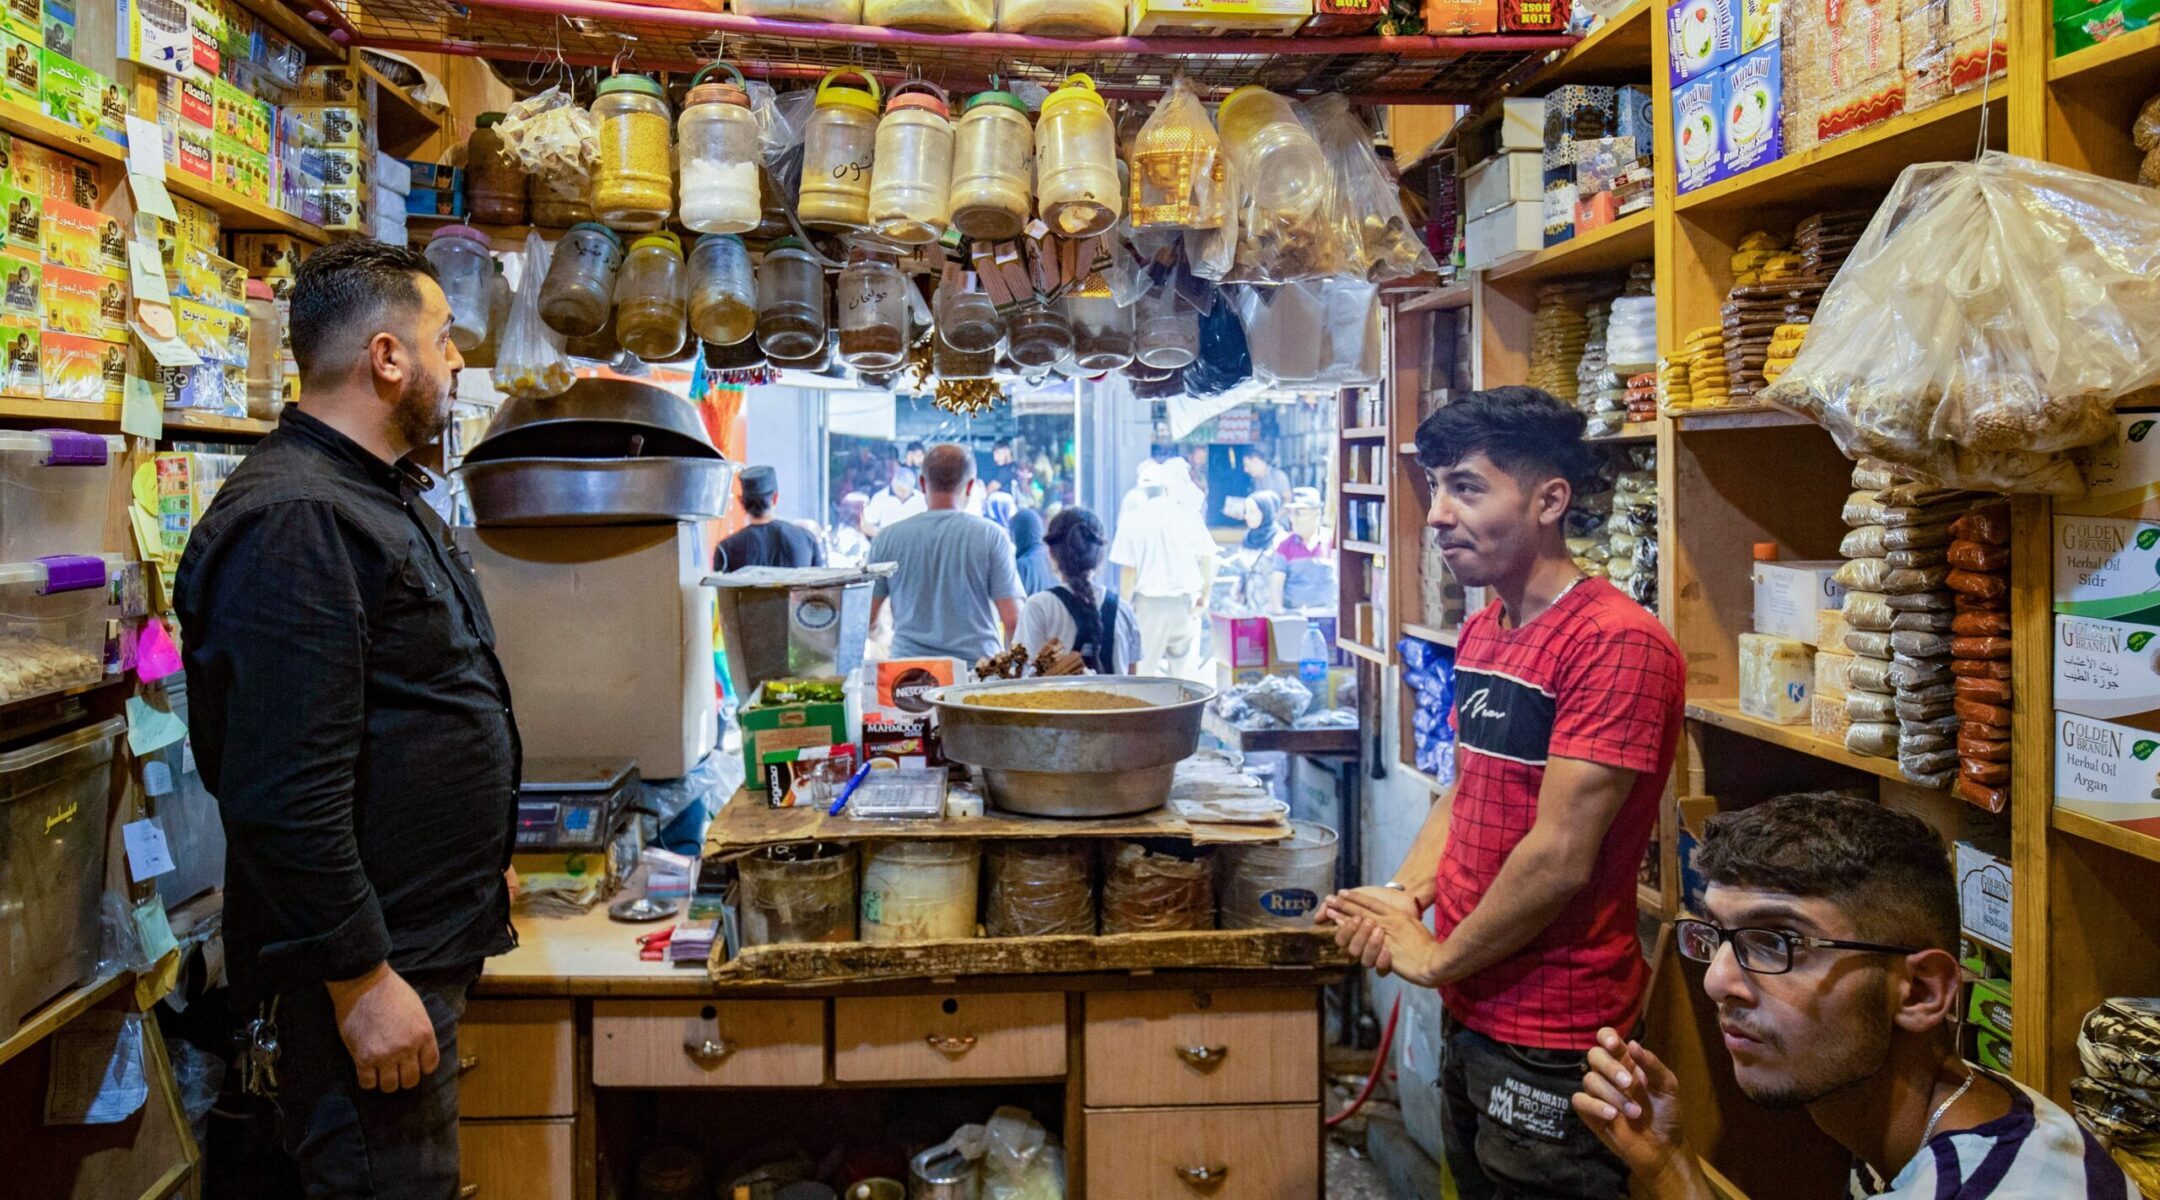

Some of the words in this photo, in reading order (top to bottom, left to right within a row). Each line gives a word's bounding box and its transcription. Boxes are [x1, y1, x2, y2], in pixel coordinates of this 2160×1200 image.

[1520, 3, 1550, 13] ROSE
[1521, 14, 1551, 24] LION
[8, 56, 38, 79] العطار
[102, 97, 126, 117] العطار
[11, 211, 39, 229] العطار
[101, 233, 126, 249] العطار
[101, 296, 126, 310] العطار
[10, 348, 38, 363] العطار
[2062, 523, 2126, 553] GOLDEN
[2078, 539, 2112, 553] BRAND
[2067, 555, 2101, 570] Herbal
[2104, 558, 2121, 571] Oil
[2078, 573, 2107, 588] Sidr
[2062, 620, 2122, 654] GOLDEN
[2075, 639, 2106, 653] BRAND
[2063, 656, 2096, 669] الأعشاب
[2099, 662, 2119, 676] زيت
[2063, 669, 2090, 683] الطيب
[2092, 675, 2119, 689] جوزة
[867, 723, 923, 733] MAHMOOD
[2062, 720, 2123, 759] GOLDEN
[2076, 741, 2108, 757] BRAND
[2066, 752, 2099, 773] Herbal
[2102, 762, 2116, 777] Oil
[2073, 772, 2108, 793] Argan
[1505, 1077, 1531, 1097] MARIO
[1532, 1086, 1569, 1111] MORATO
[1518, 1096, 1566, 1122] PROJECT
